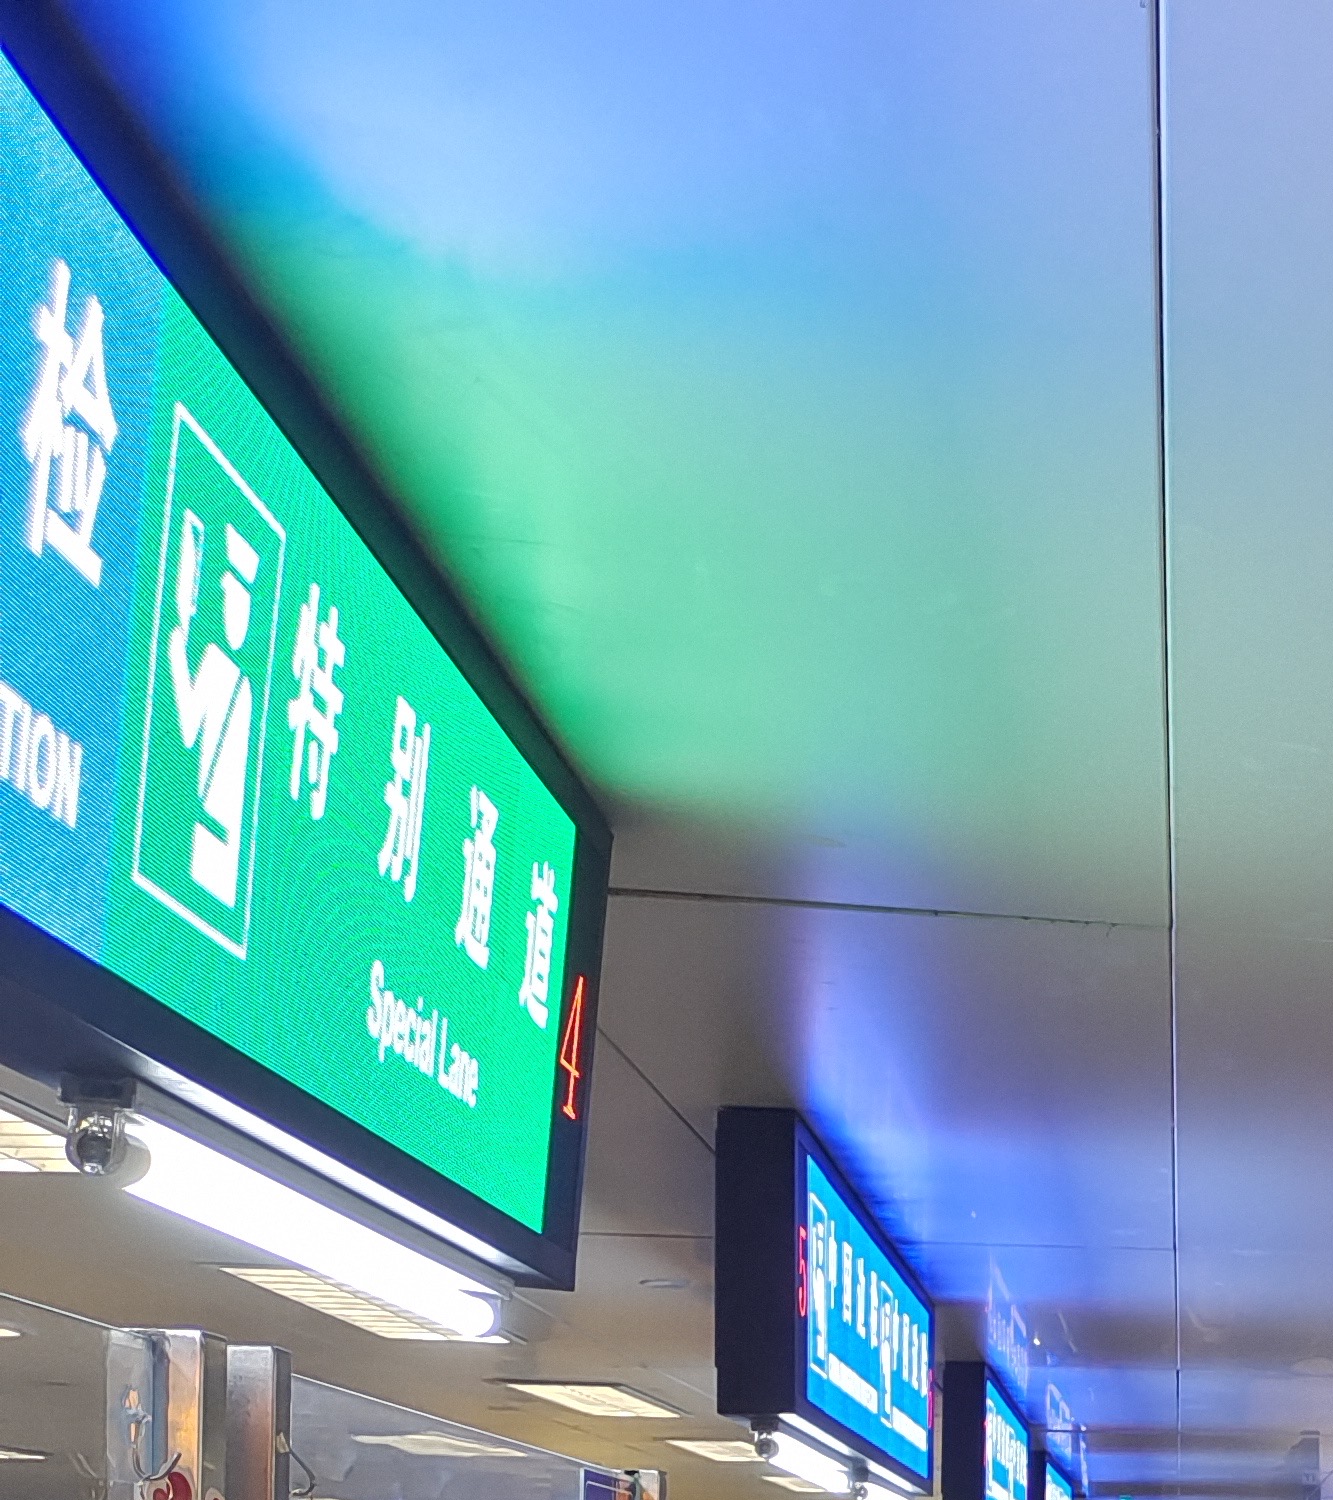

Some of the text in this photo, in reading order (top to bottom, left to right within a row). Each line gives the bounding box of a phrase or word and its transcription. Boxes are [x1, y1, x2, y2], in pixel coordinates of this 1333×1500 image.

[287, 582, 559, 1029] 特别通道
[366, 959, 479, 1109] Special Lane
[560, 975, 584, 1120] 4
